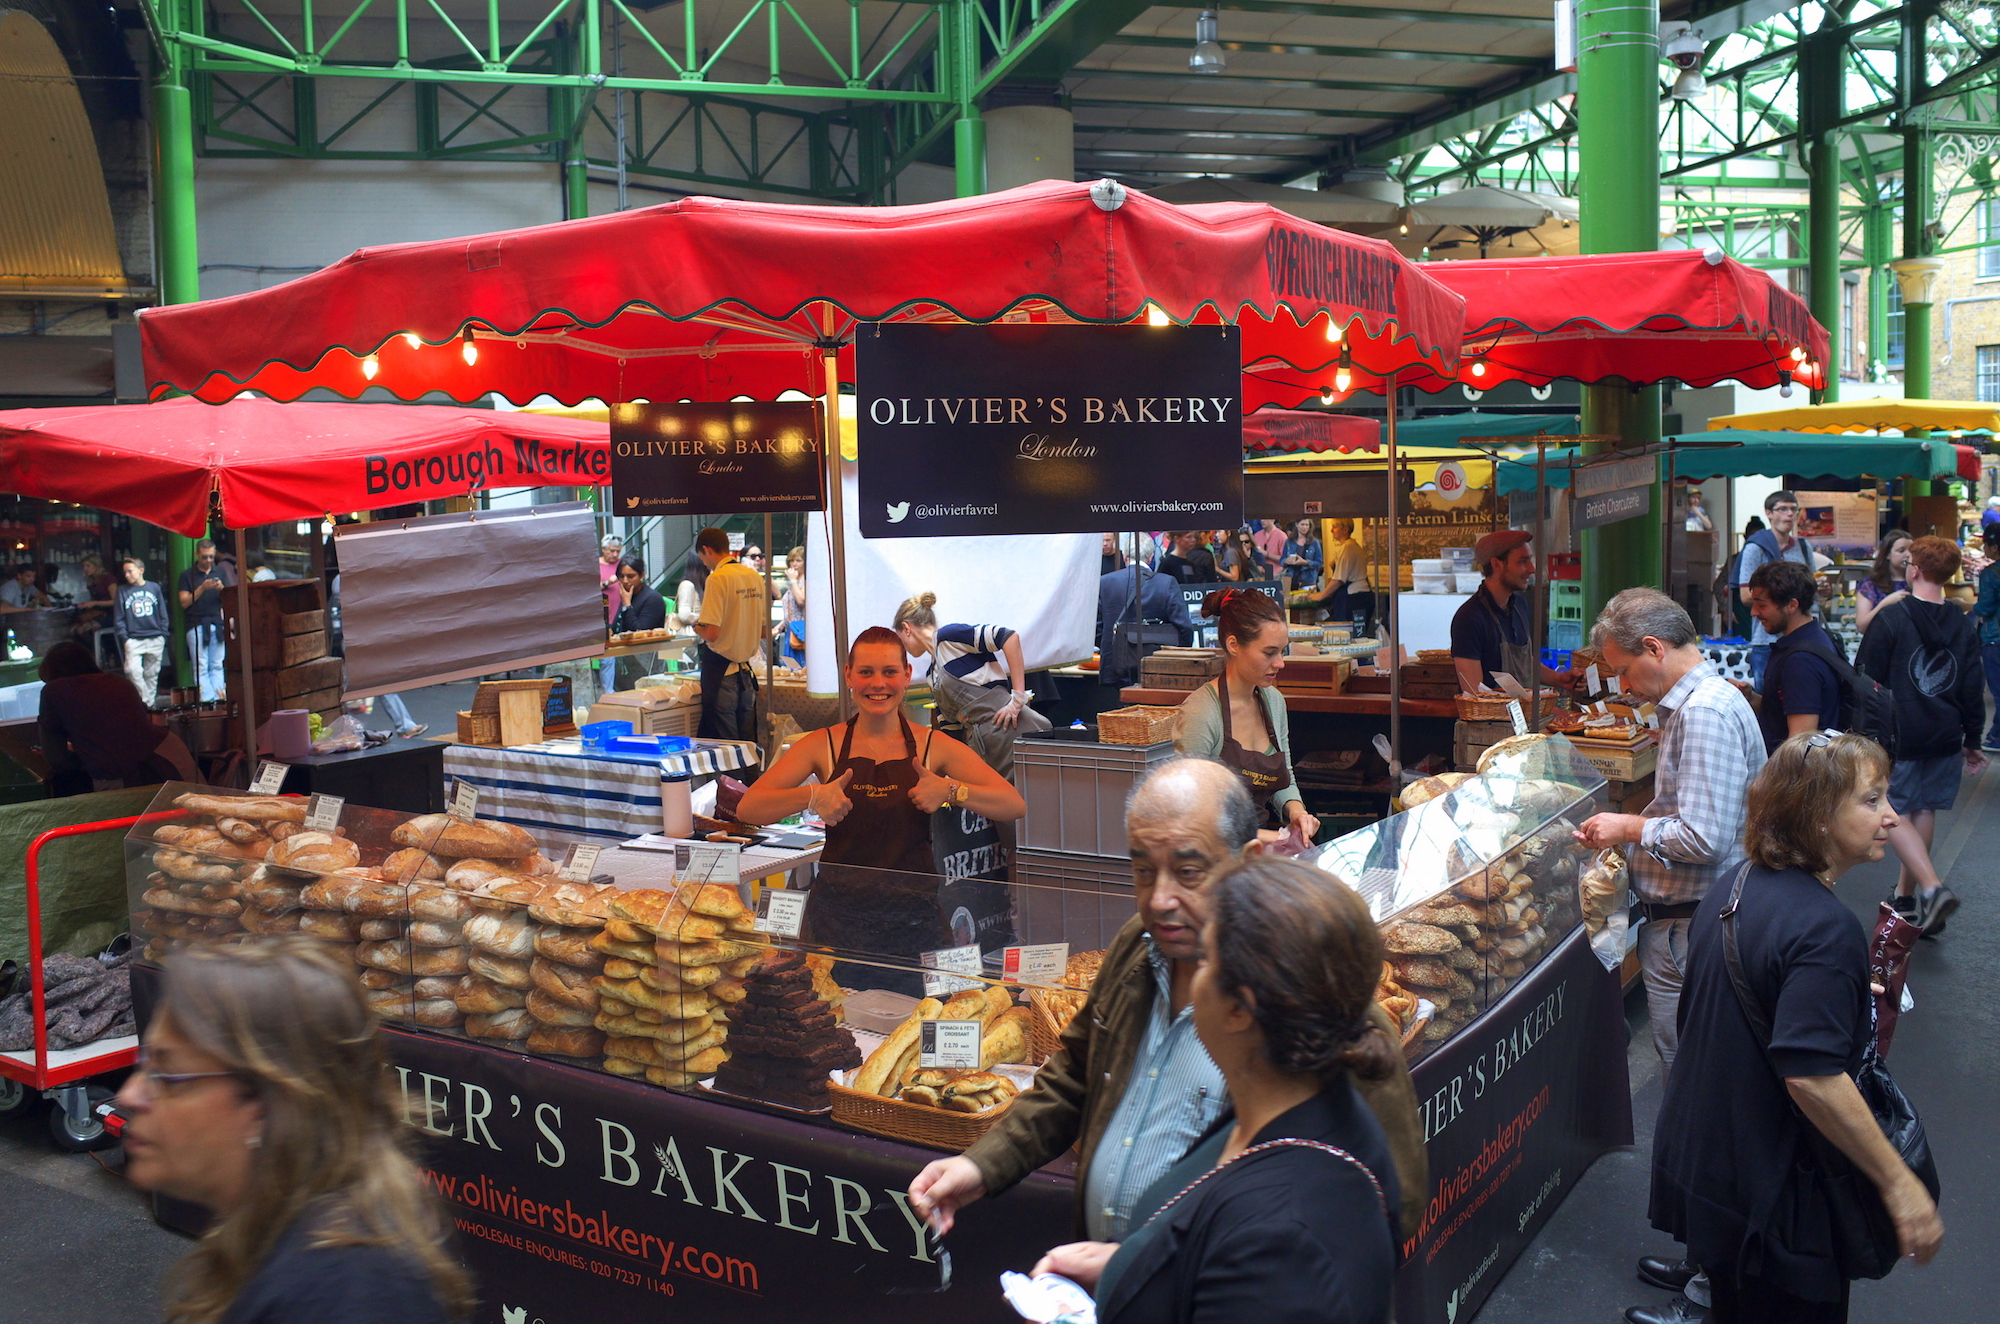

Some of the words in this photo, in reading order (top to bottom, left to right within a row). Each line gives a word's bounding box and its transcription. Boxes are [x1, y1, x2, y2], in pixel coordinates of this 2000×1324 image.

[1083, 397, 1233, 423] BAKERY
[735, 438, 818, 454] BAKERY
[1016, 433, 1099, 461] London
[365, 440, 503, 494] Borough
[513, 439, 612, 476] Marke
[697, 459, 744, 475] London
[739, 494, 817, 504] www.oliviersbakery.com
[1090, 500, 1224, 514] www.oliviersbakery.com
[1586, 501, 1607, 519] British
[915, 503, 998, 519] @olivierfavrel
[1406, 512, 1446, 525] Farm
[1183, 590, 1203, 601] DID
[132, 599, 153, 617] 66
[1493, 979, 1567, 1083] BAKERY
[1402, 1085, 1549, 1258] ww.oliviersbakery.com
[595, 1118, 937, 1263] BAKERY
[411, 1164, 759, 1290] ww.oliviersbakery.com
[1426, 1217, 1458, 1266] WHOLESALE
[454, 1217, 523, 1250] WHOLESALE
[590, 1261, 611, 1278] 020
[614, 1266, 642, 1287] 7237
[646, 1276, 675, 1297] 1140
